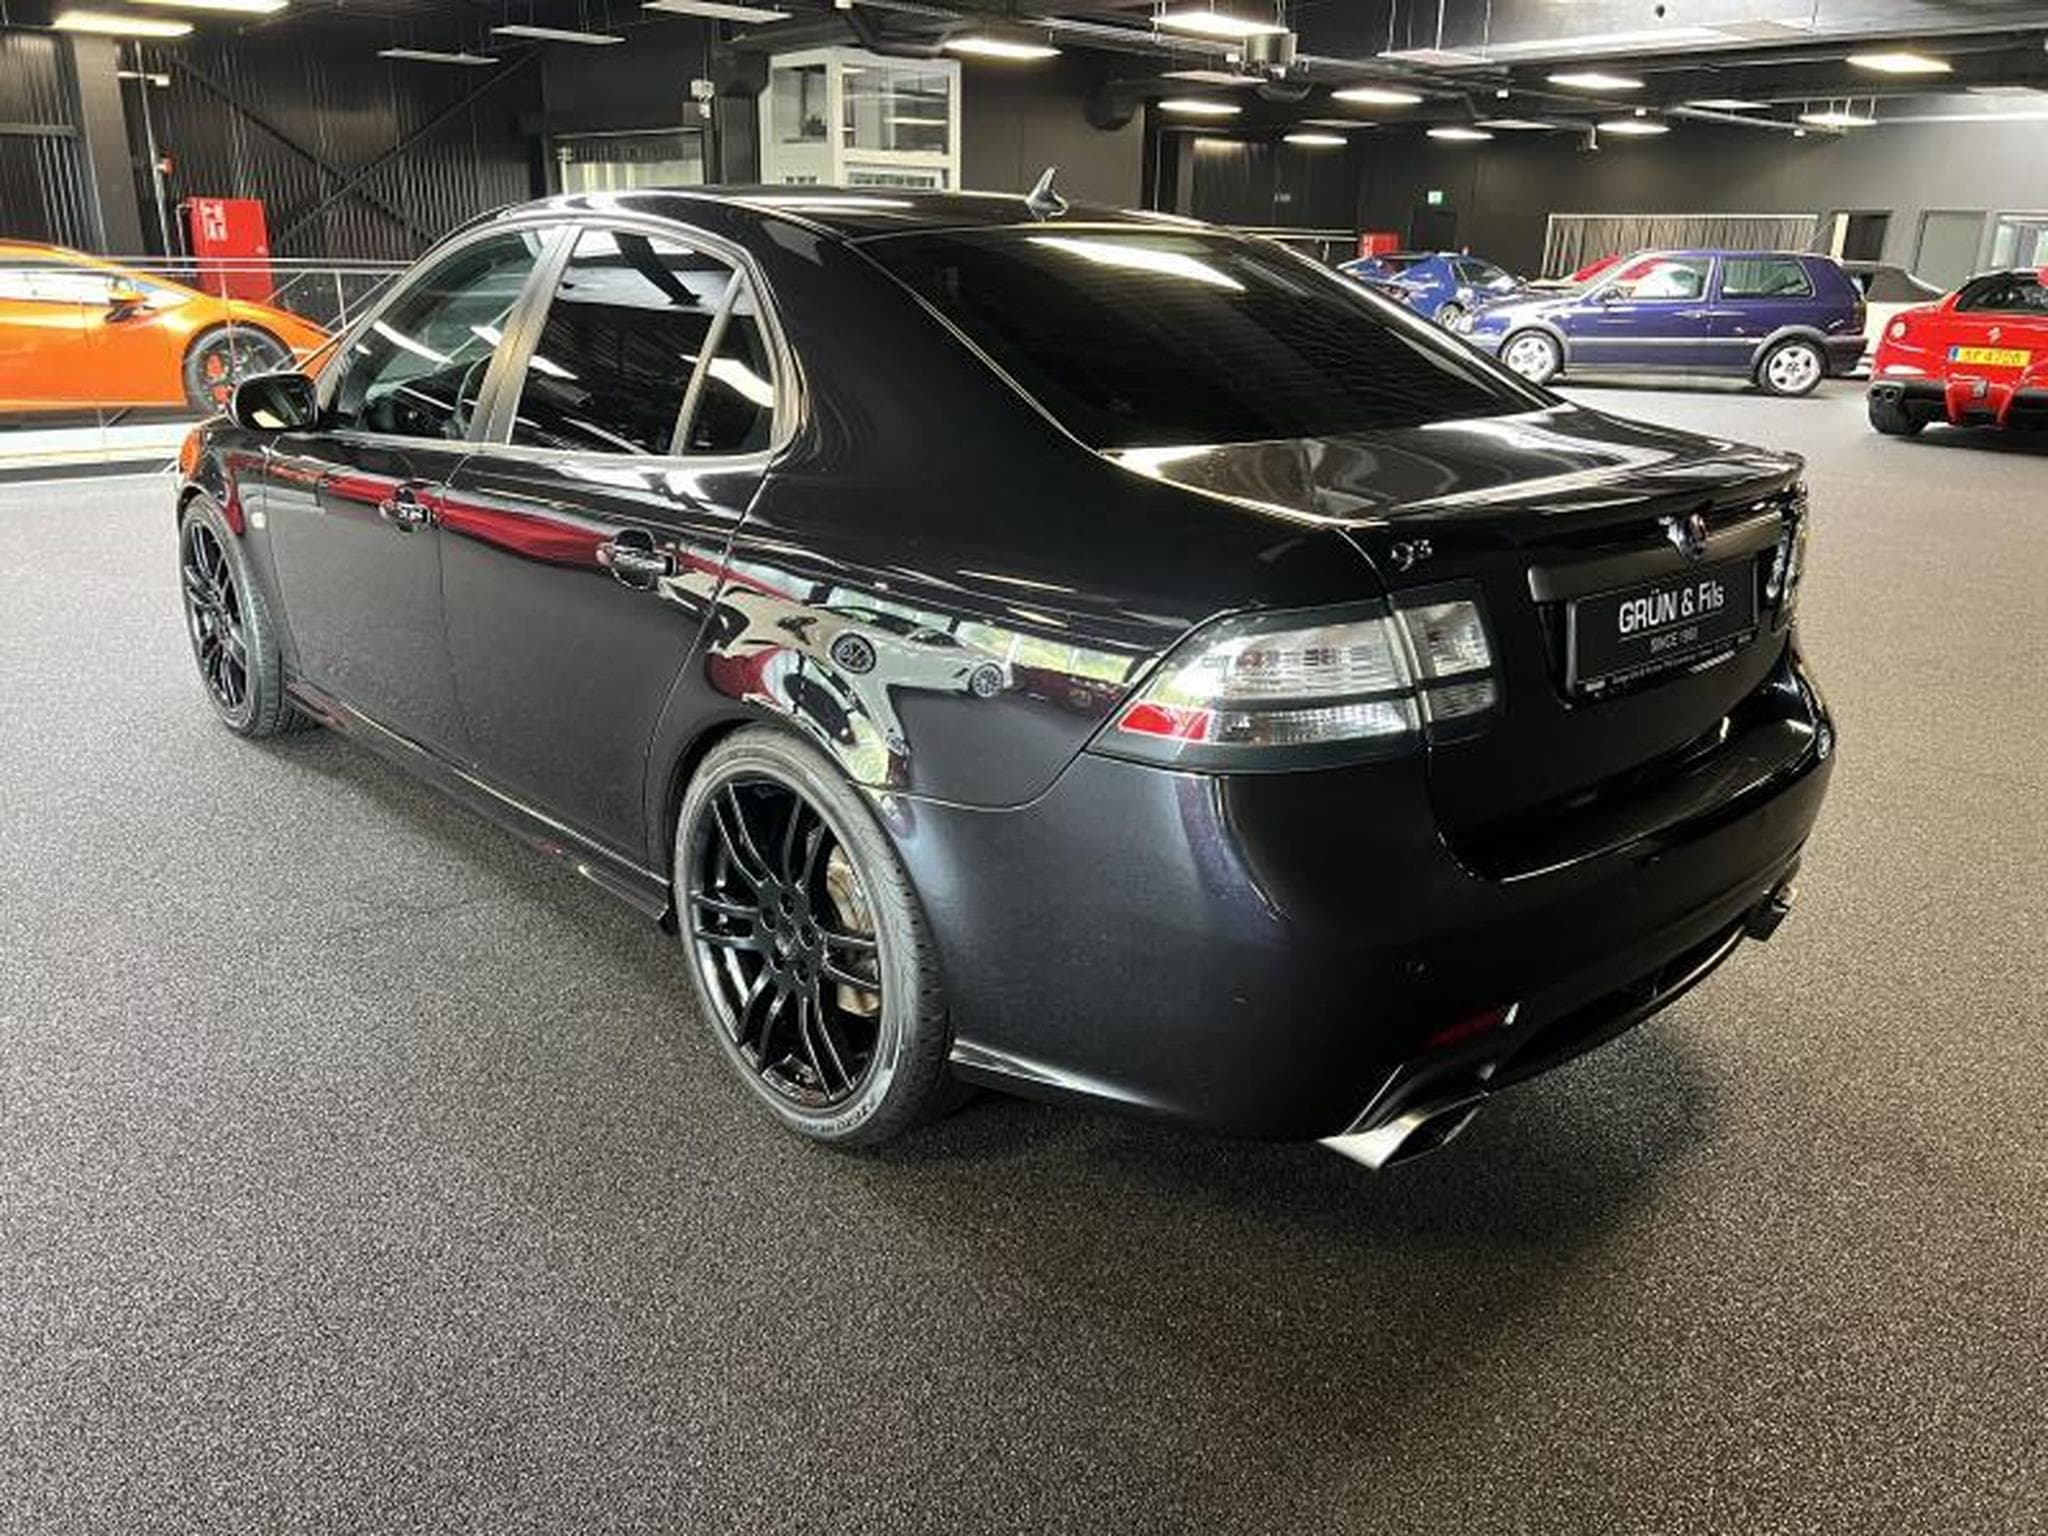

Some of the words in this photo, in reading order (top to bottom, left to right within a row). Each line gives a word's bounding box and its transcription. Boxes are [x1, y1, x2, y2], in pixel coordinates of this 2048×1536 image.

[1619, 588, 1679, 633] GRÜN
[1681, 587, 1694, 617] &
[1698, 579, 1725, 612] Fils
